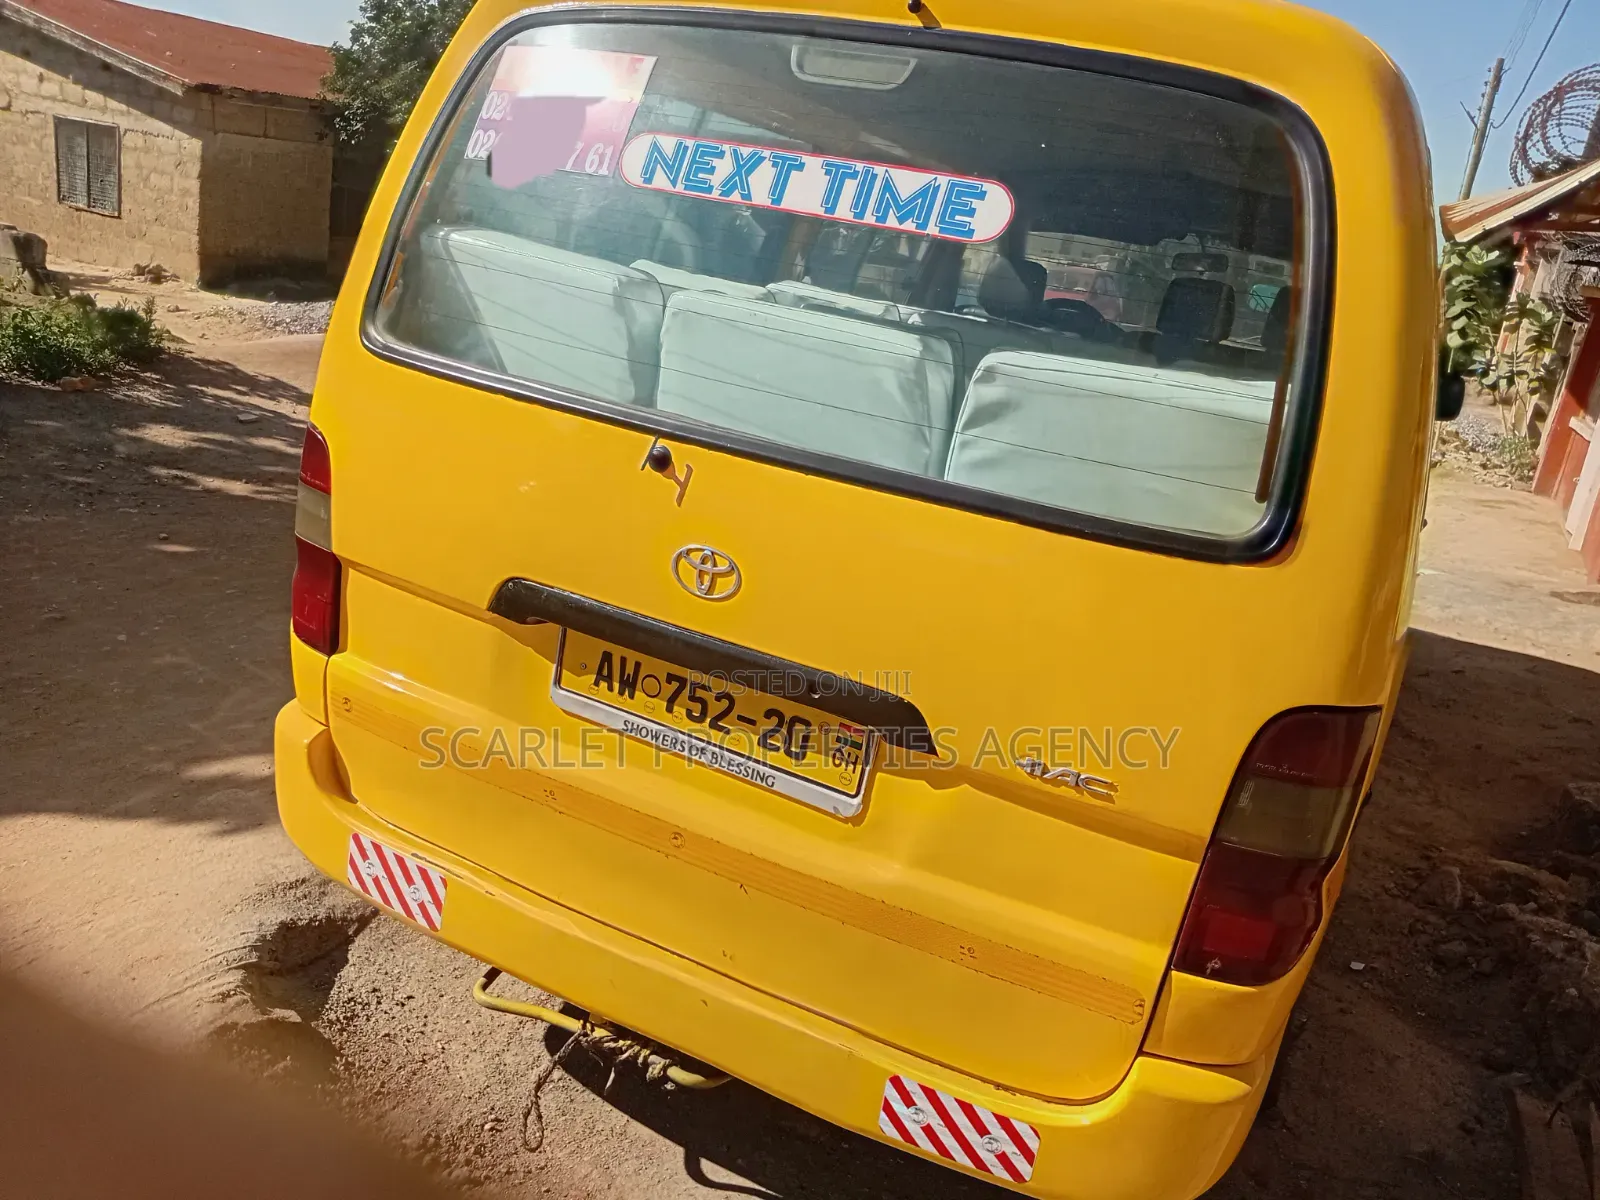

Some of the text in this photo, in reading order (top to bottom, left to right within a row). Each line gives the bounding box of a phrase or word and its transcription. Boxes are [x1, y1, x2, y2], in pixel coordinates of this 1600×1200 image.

[641, 135, 989, 240] NEXT TIME
[593, 650, 812, 762] AW 752-20
[621, 719, 776, 788] SHOWERS OF BLESSING
